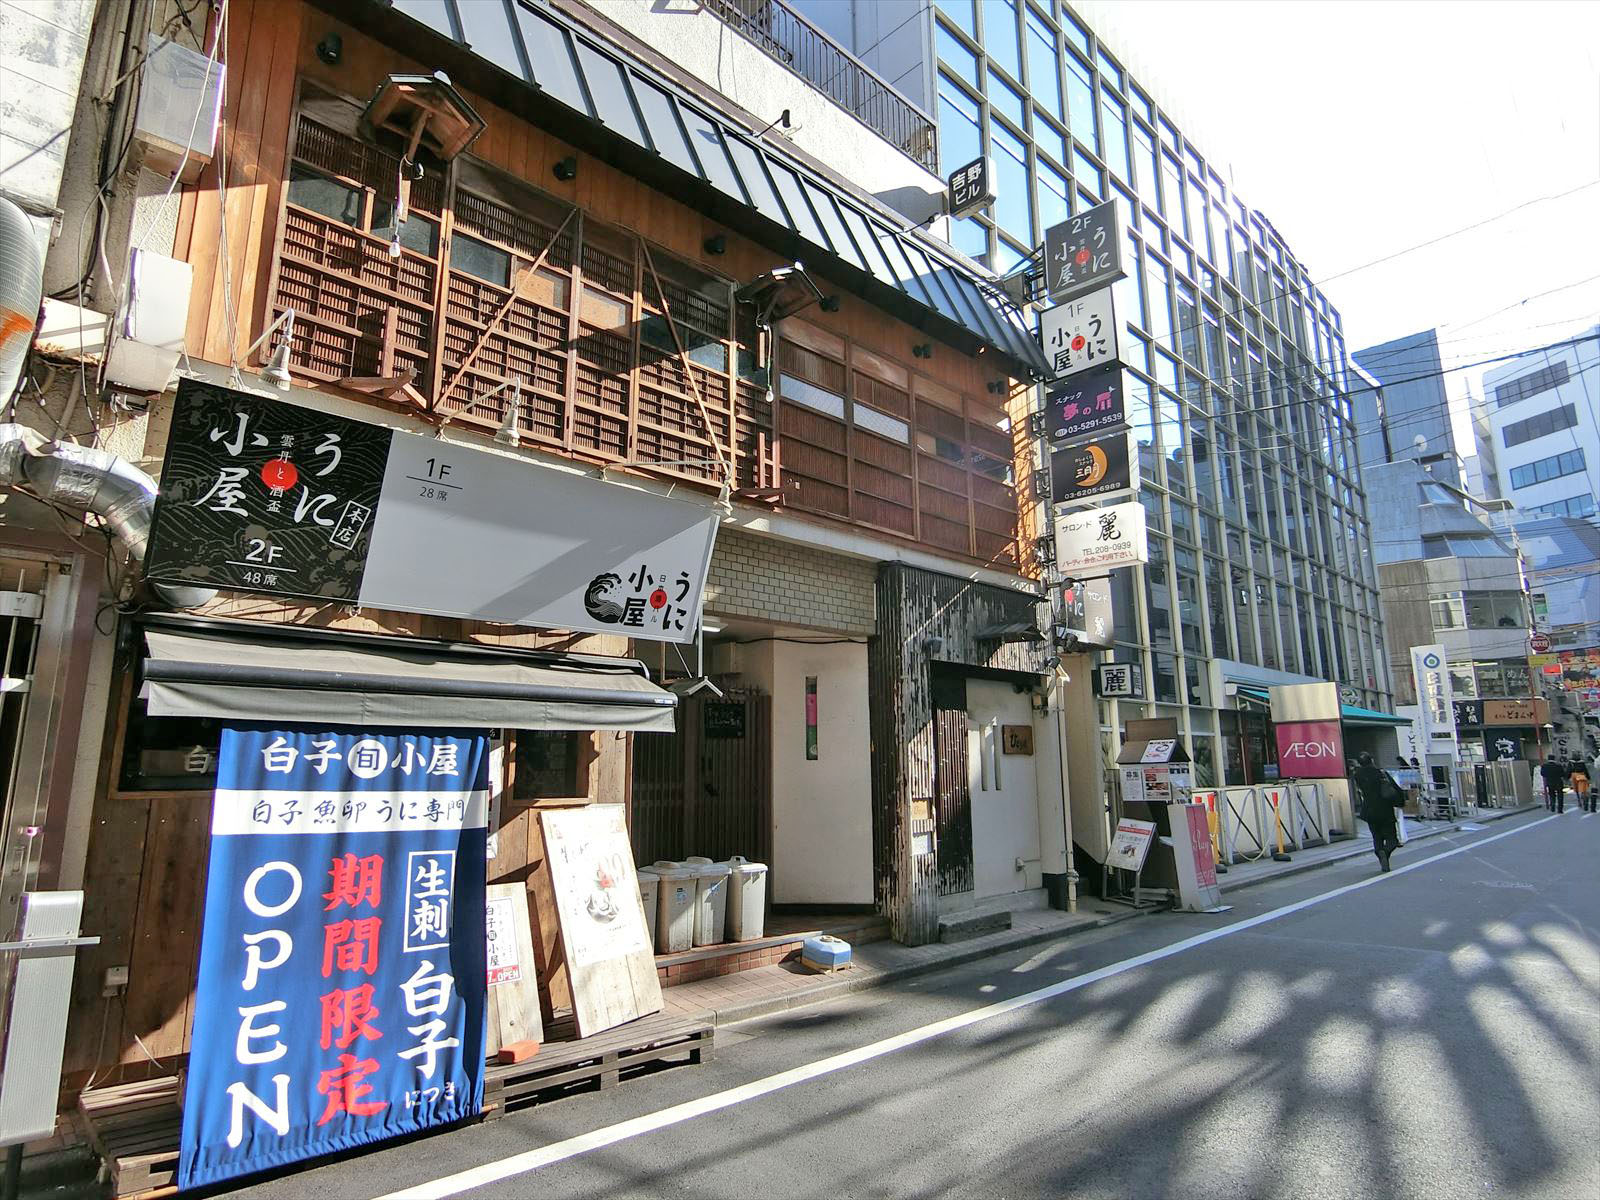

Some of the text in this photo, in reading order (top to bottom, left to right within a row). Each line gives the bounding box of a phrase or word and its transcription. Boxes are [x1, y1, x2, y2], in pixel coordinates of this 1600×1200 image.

[952, 162, 982, 192] 吉野
[954, 184, 981, 206] ビル
[1072, 215, 1092, 235] 2F
[1054, 241, 1077, 289] 小屋
[1093, 226, 1111, 273] うに
[1067, 302, 1085, 318] 1F
[1051, 326, 1074, 373] 小屋
[1087, 313, 1107, 361] うに
[1055, 391, 1082, 405] スナック
[1068, 412, 1122, 434] 03-5291-5539
[192, 412, 270, 518] 小屋
[293, 433, 342, 527] うに
[425, 457, 452, 481] 1F
[335, 506, 365, 544] 本店
[1096, 511, 1122, 541] 麗
[245, 538, 284, 565] 2F
[619, 564, 655, 628] 小屋
[662, 570, 690, 632] うに
[1104, 668, 1128, 692] 麗
[225, 860, 303, 1149] OPEN
[316, 852, 388, 1128] 期間限定
